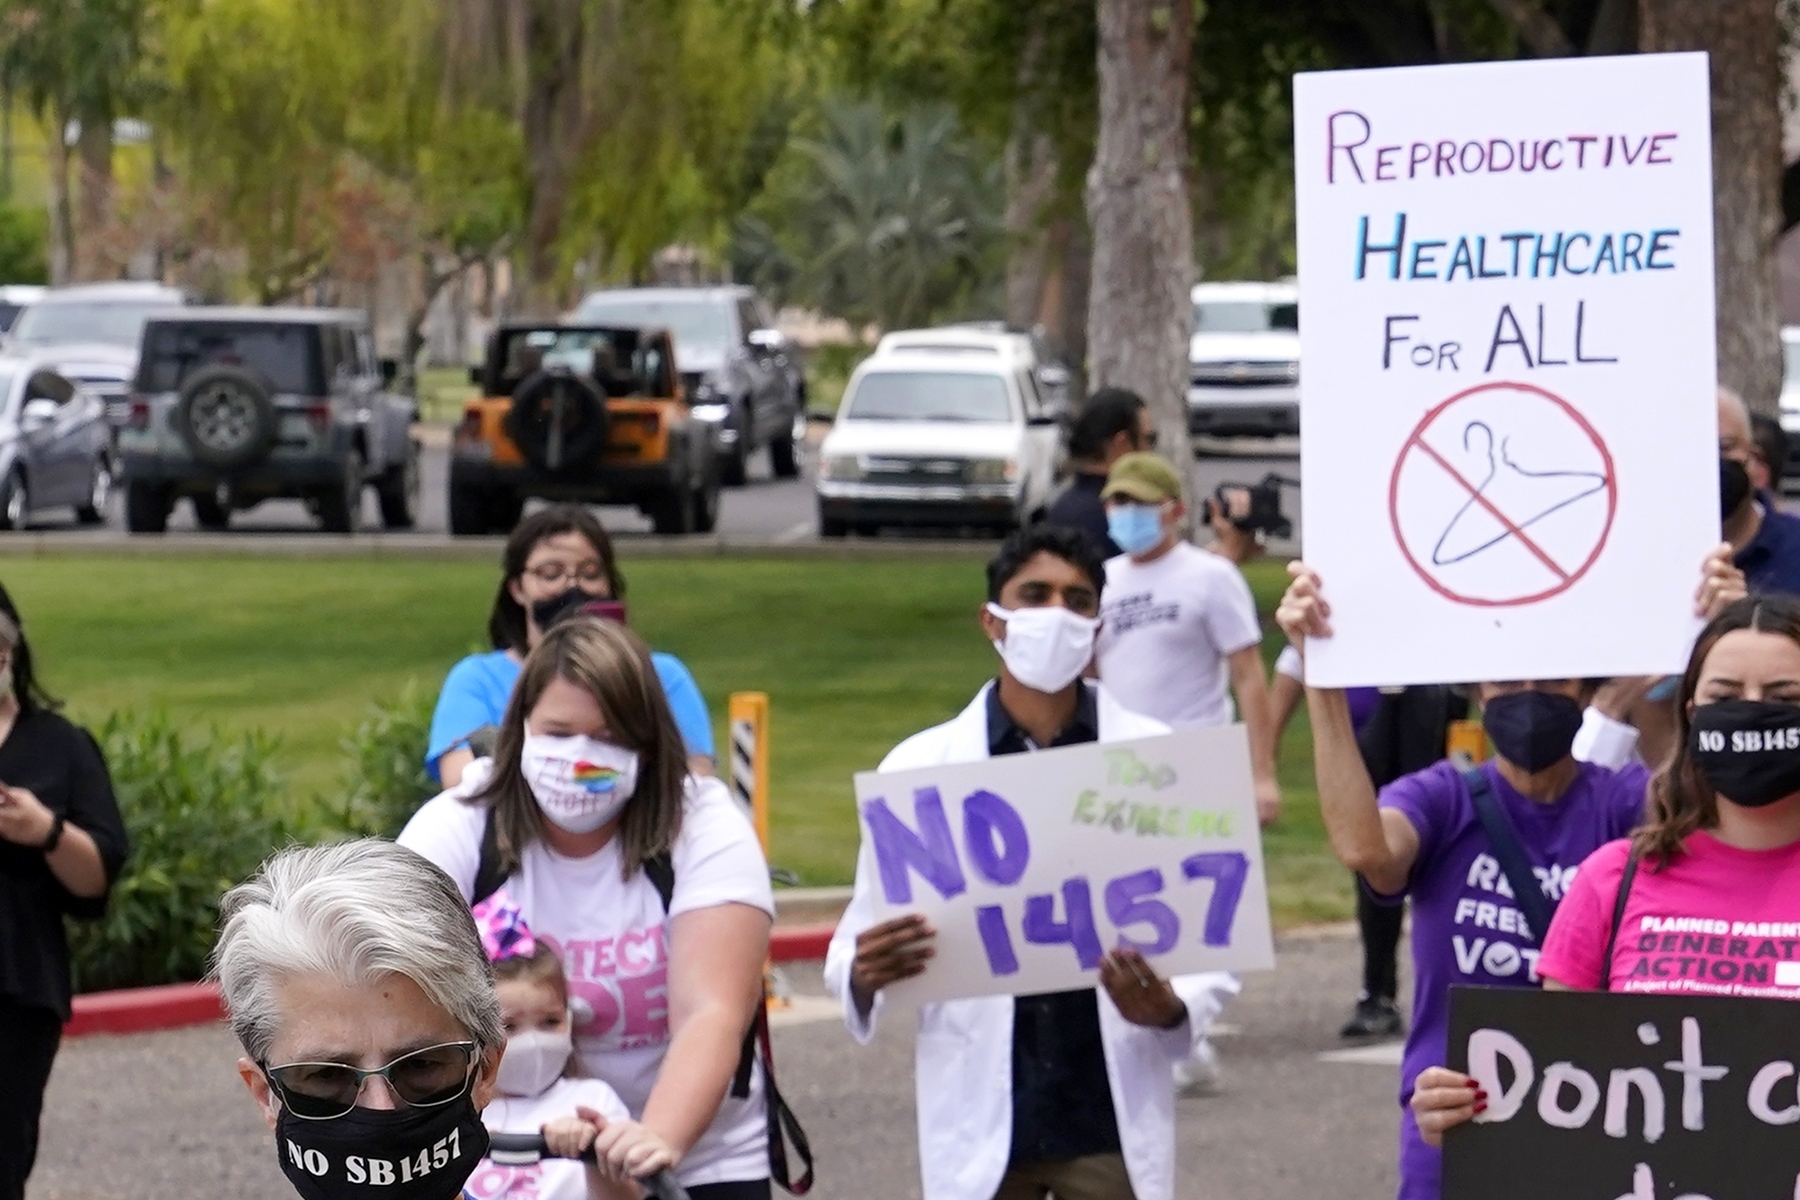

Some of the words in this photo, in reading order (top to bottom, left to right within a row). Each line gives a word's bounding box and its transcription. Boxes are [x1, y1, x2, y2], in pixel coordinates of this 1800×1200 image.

[1327, 111, 1679, 183] REPRODUCTIVE
[1354, 212, 1680, 281] HEALTHCARE
[1485, 300, 1618, 373] ALL
[1699, 730, 1725, 752] NO
[862, 786, 1029, 905] NO
[976, 851, 1249, 977] 1457
[1640, 916, 1729, 935] PLANNED
[1628, 957, 1769, 983] ACTION
[286, 1138, 329, 1176] NO
[345, 1127, 461, 1185] SB1457
